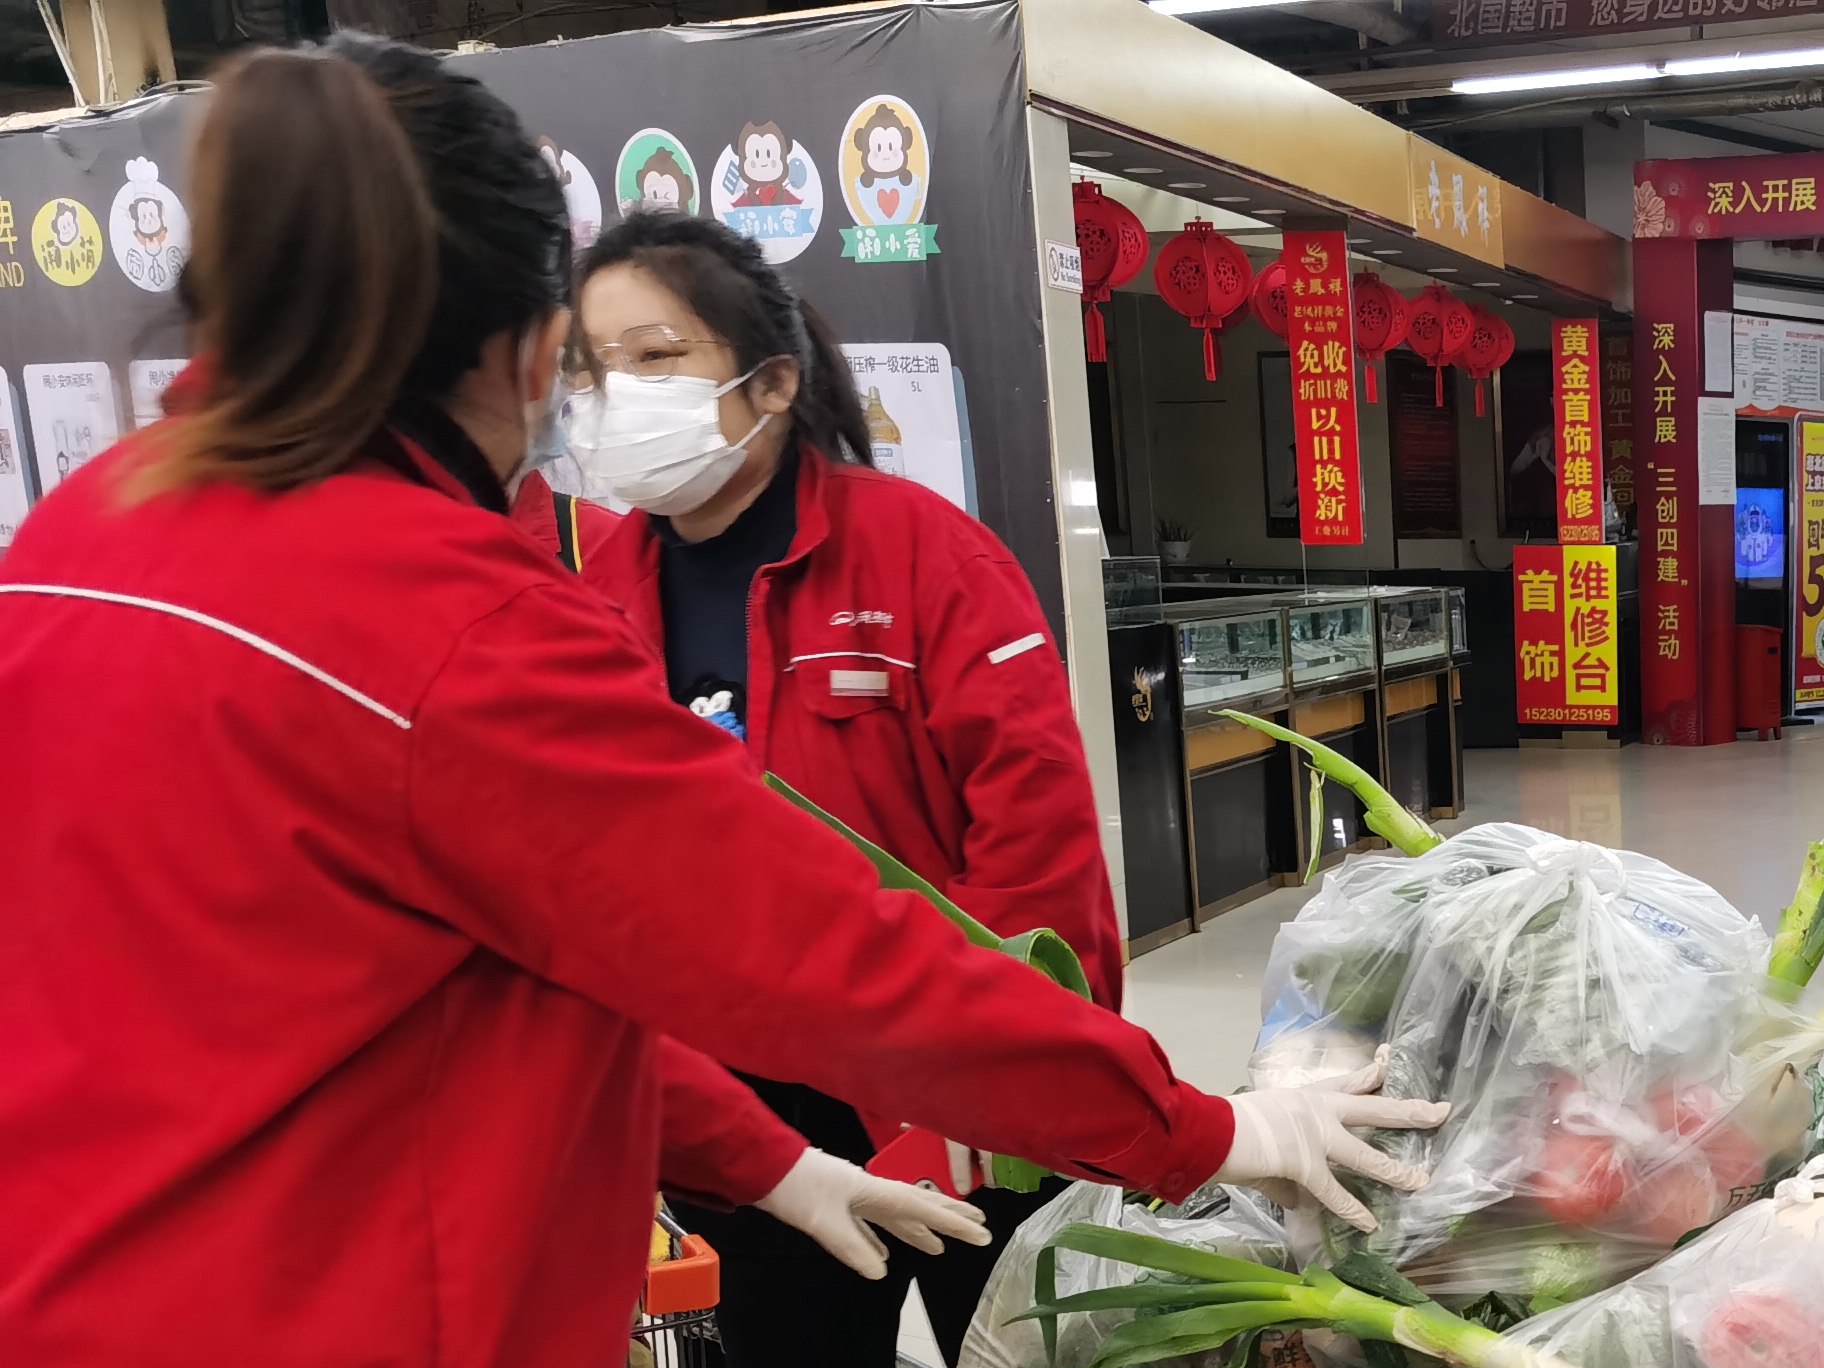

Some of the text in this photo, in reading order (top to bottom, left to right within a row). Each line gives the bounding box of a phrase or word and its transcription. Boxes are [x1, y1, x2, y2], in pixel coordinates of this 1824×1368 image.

[1707, 177, 1817, 215] 深入开展
[1297, 340, 1347, 373] 免收
[1299, 378, 1348, 401] 折旧费
[1652, 323, 1677, 443] 深入开展
[1311, 406, 1346, 522] 以旧换新
[1560, 325, 1594, 519] 黄金首饰维修
[1518, 569, 1560, 682] 首饰
[1569, 560, 1611, 693] 维修台
[1657, 604, 1680, 660] 活动
[1524, 708, 1611, 721] 15230125195
